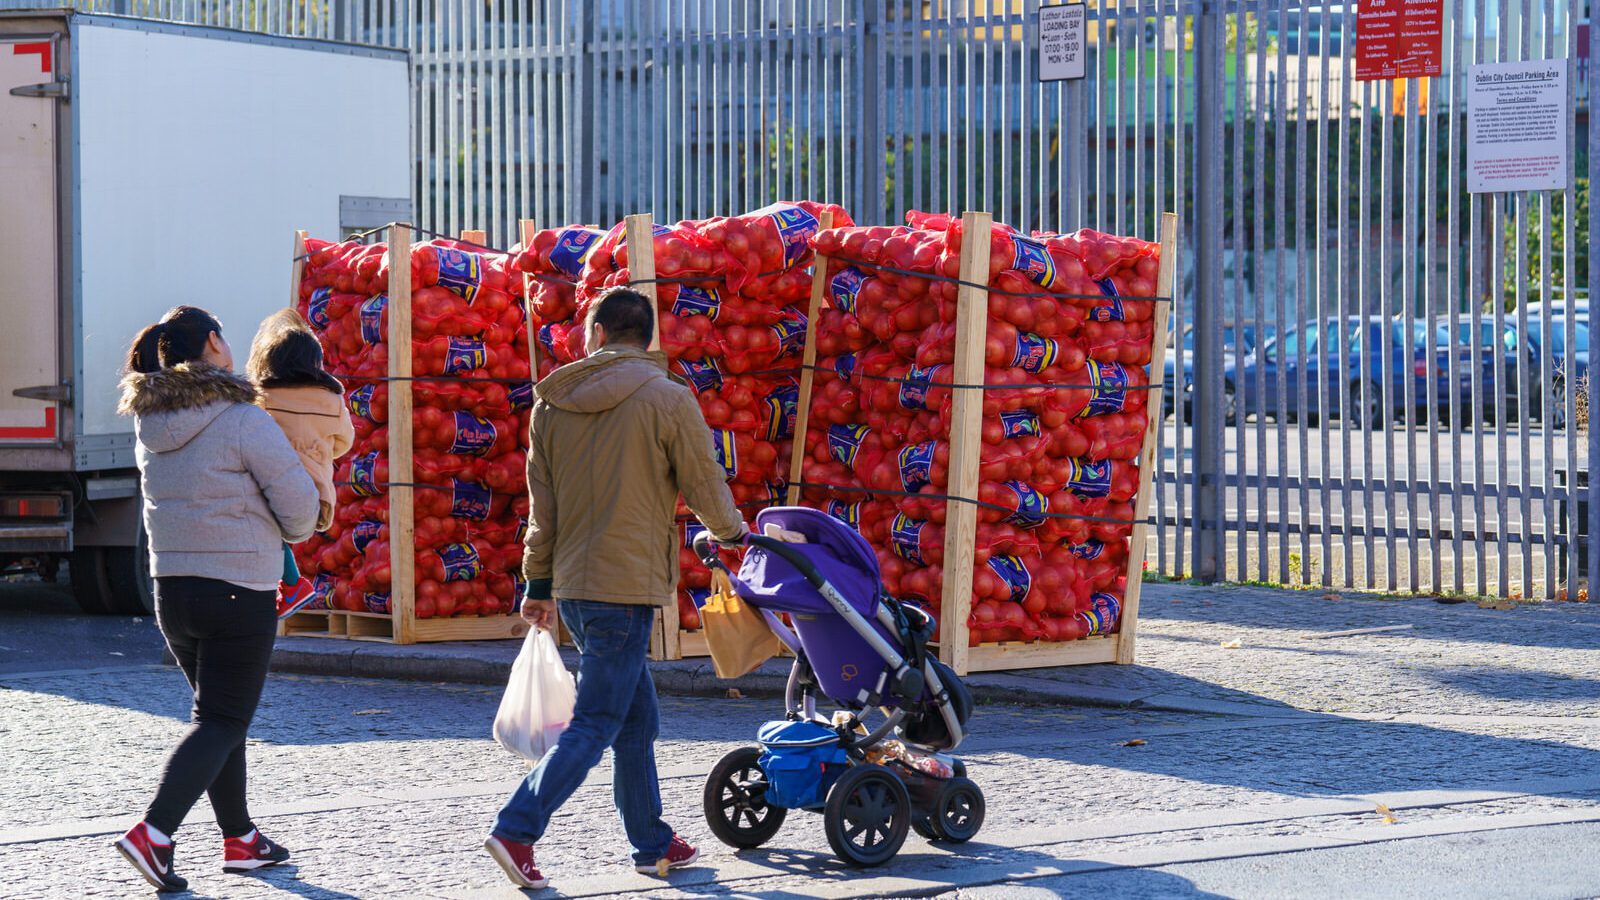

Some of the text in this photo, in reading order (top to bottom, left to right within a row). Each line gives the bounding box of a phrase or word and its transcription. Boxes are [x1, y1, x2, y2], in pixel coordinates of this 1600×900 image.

[1044, 20, 1080, 31] LOADING BAY
[1048, 55, 1061, 64] MON
[1065, 53, 1075, 62] SAT
[1476, 74, 1492, 82] Dublin
[1493, 73, 1503, 82] City
[1505, 72, 1523, 80] Council
[1525, 71, 1545, 80] Parking
